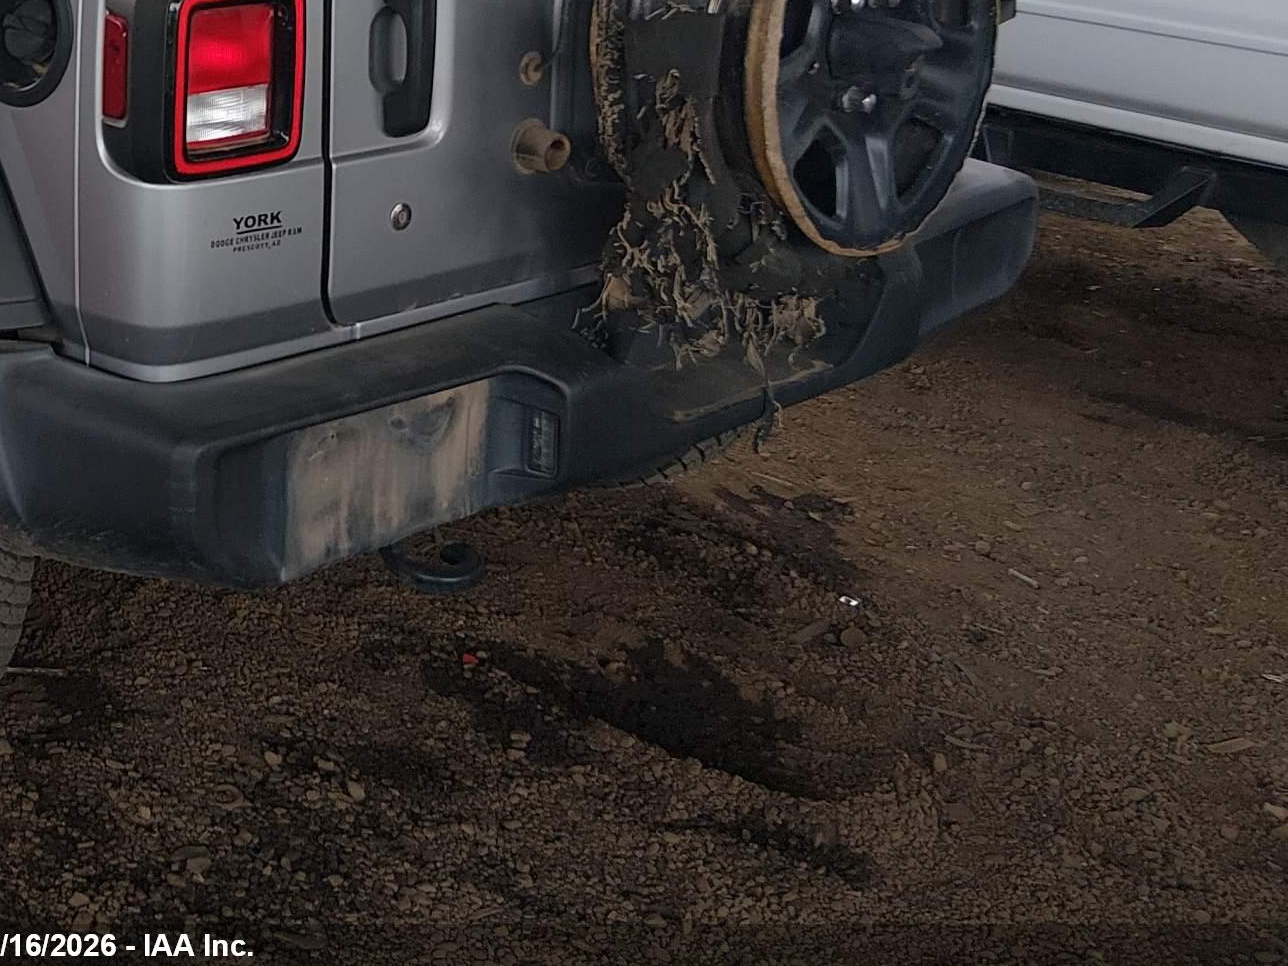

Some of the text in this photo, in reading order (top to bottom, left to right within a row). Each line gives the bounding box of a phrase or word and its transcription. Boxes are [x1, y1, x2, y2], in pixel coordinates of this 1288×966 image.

[232, 210, 282, 230] YORK
[211, 227, 302, 249] DODGE CHRYSLER JEEP RAM
